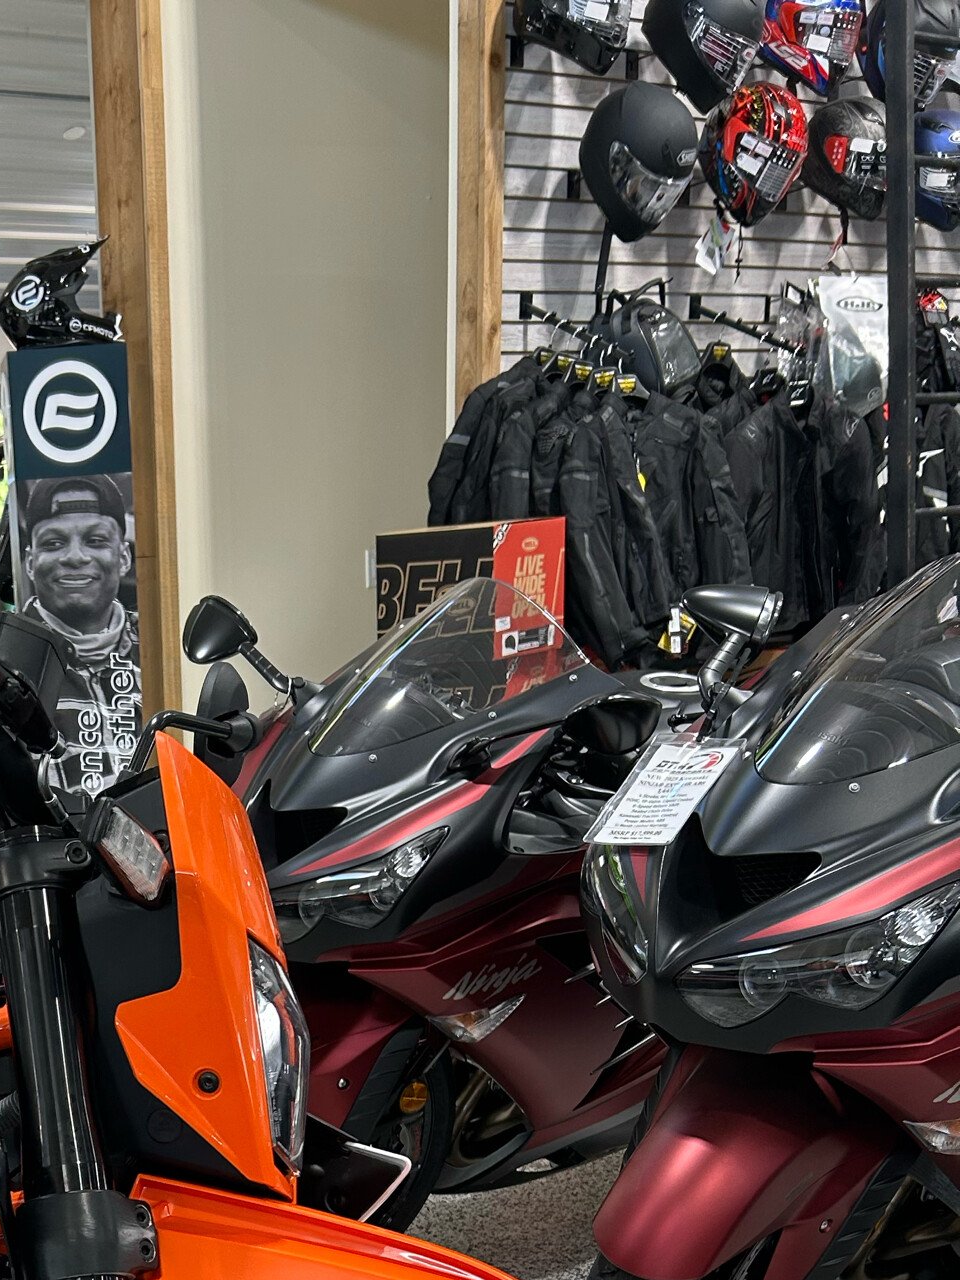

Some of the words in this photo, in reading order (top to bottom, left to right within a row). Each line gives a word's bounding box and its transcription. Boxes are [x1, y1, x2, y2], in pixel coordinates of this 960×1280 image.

[82, 323, 114, 339] CFMOTO
[515, 554, 544, 578] LIVE
[513, 573, 546, 600] WIDE
[442, 952, 543, 1003] Ninja
